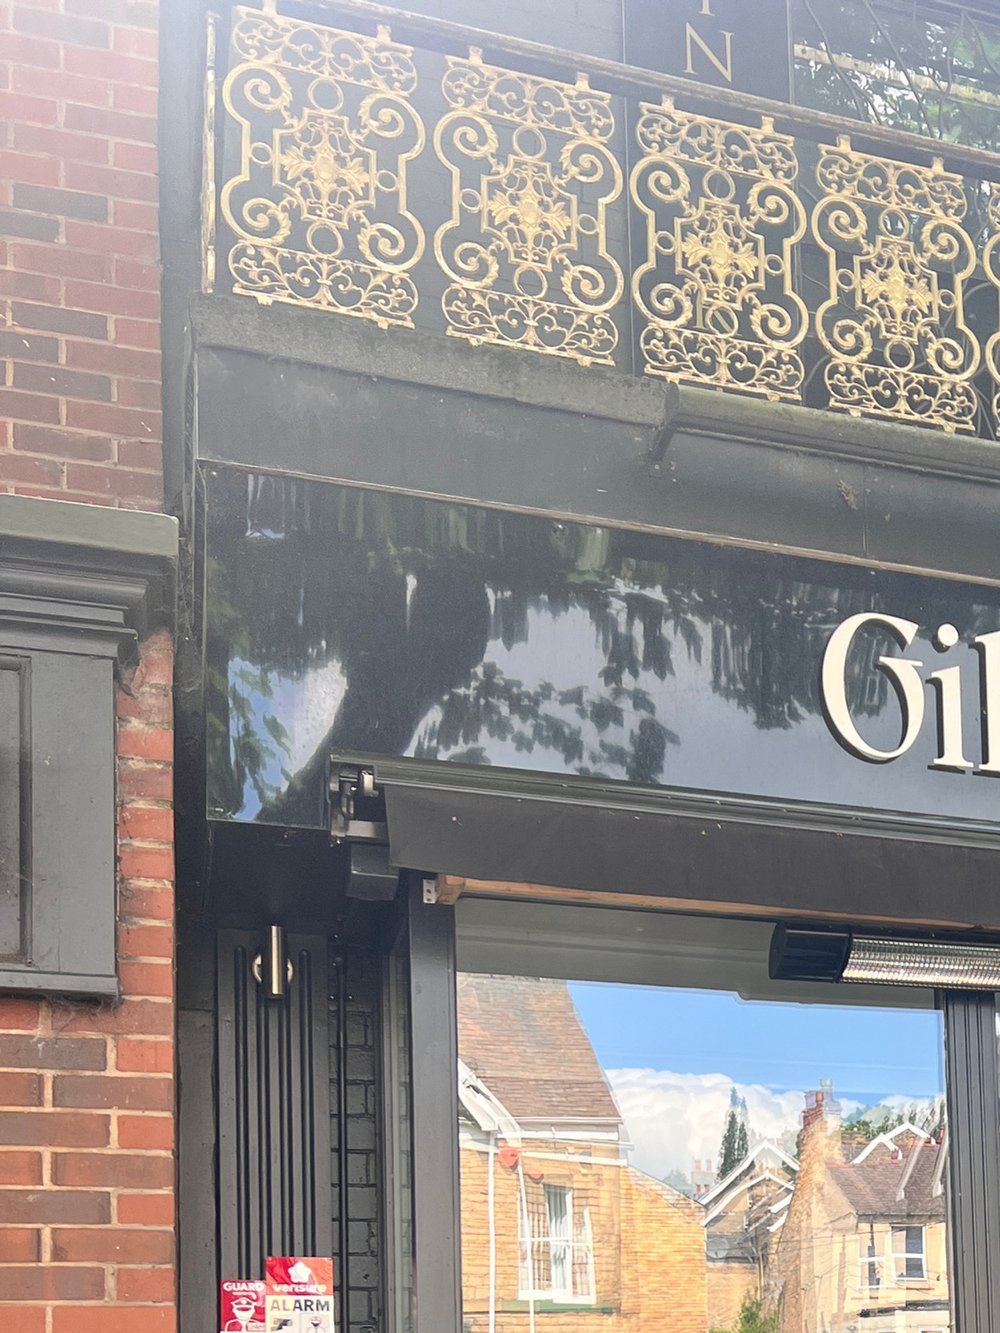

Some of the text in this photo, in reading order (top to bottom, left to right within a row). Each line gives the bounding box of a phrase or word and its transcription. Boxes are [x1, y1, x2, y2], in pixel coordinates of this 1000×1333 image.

[223, 1282, 264, 1292] GUARD
[272, 1283, 327, 1293] verisure
[270, 1299, 330, 1312] ALARM
